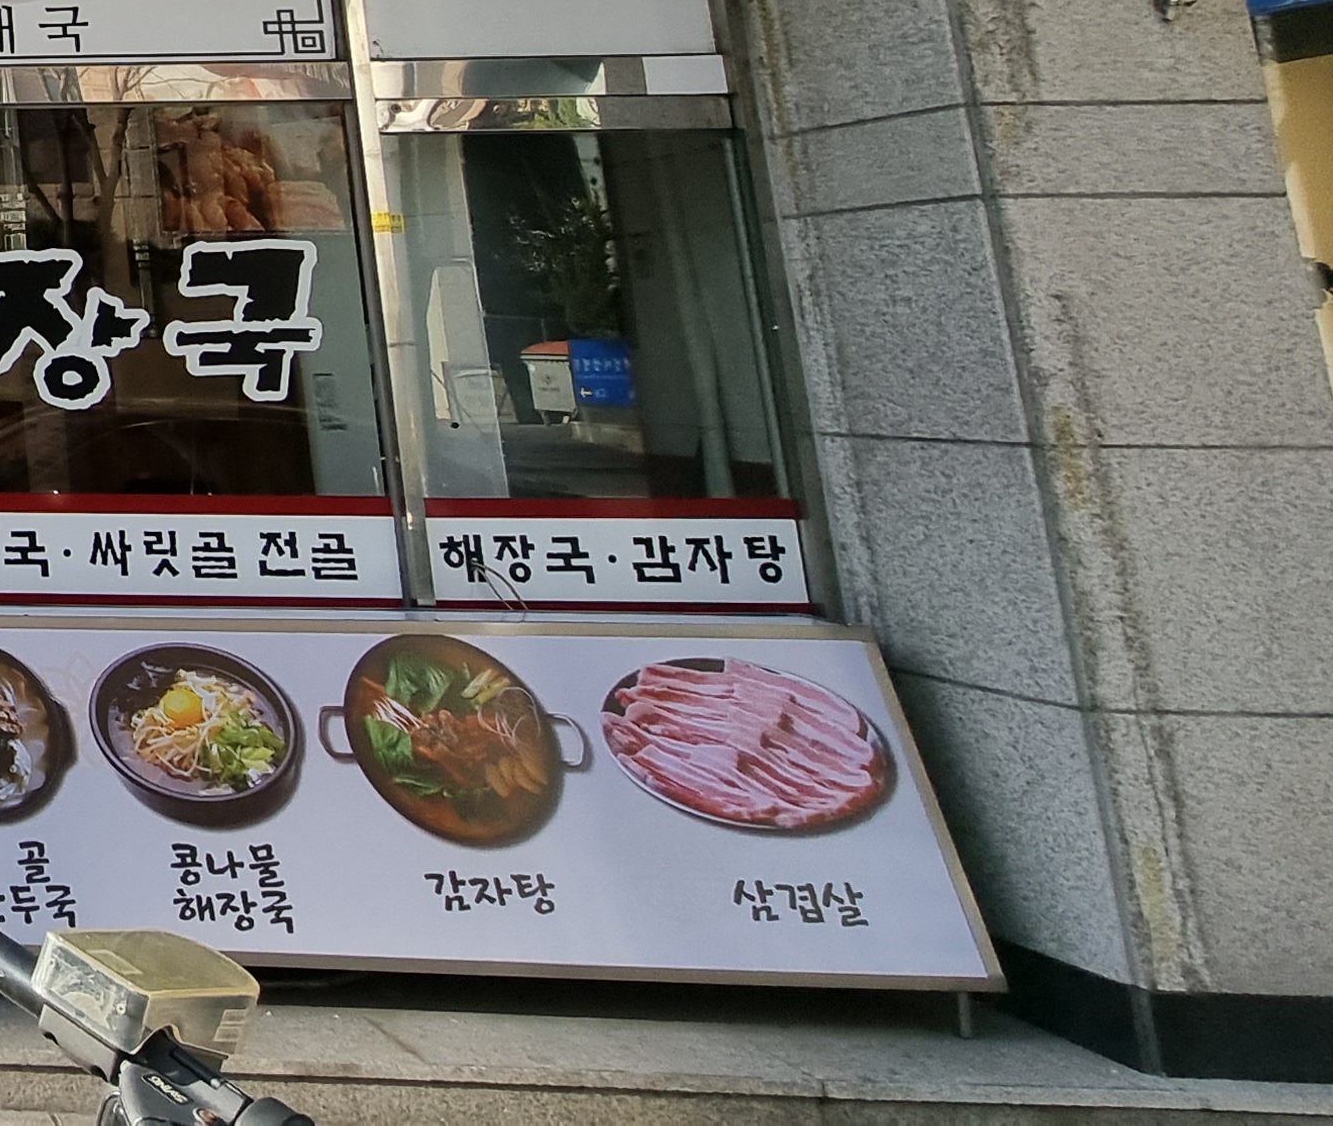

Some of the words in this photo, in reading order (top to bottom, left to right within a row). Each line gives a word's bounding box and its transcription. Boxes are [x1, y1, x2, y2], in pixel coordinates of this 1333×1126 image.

[259, 532, 358, 580] 전골
[171, 843, 284, 887] 콩나물
[173, 889, 293, 933] 해장국
[424, 871, 554, 914] 감자탕
[734, 880, 869, 926] 삼겹살
